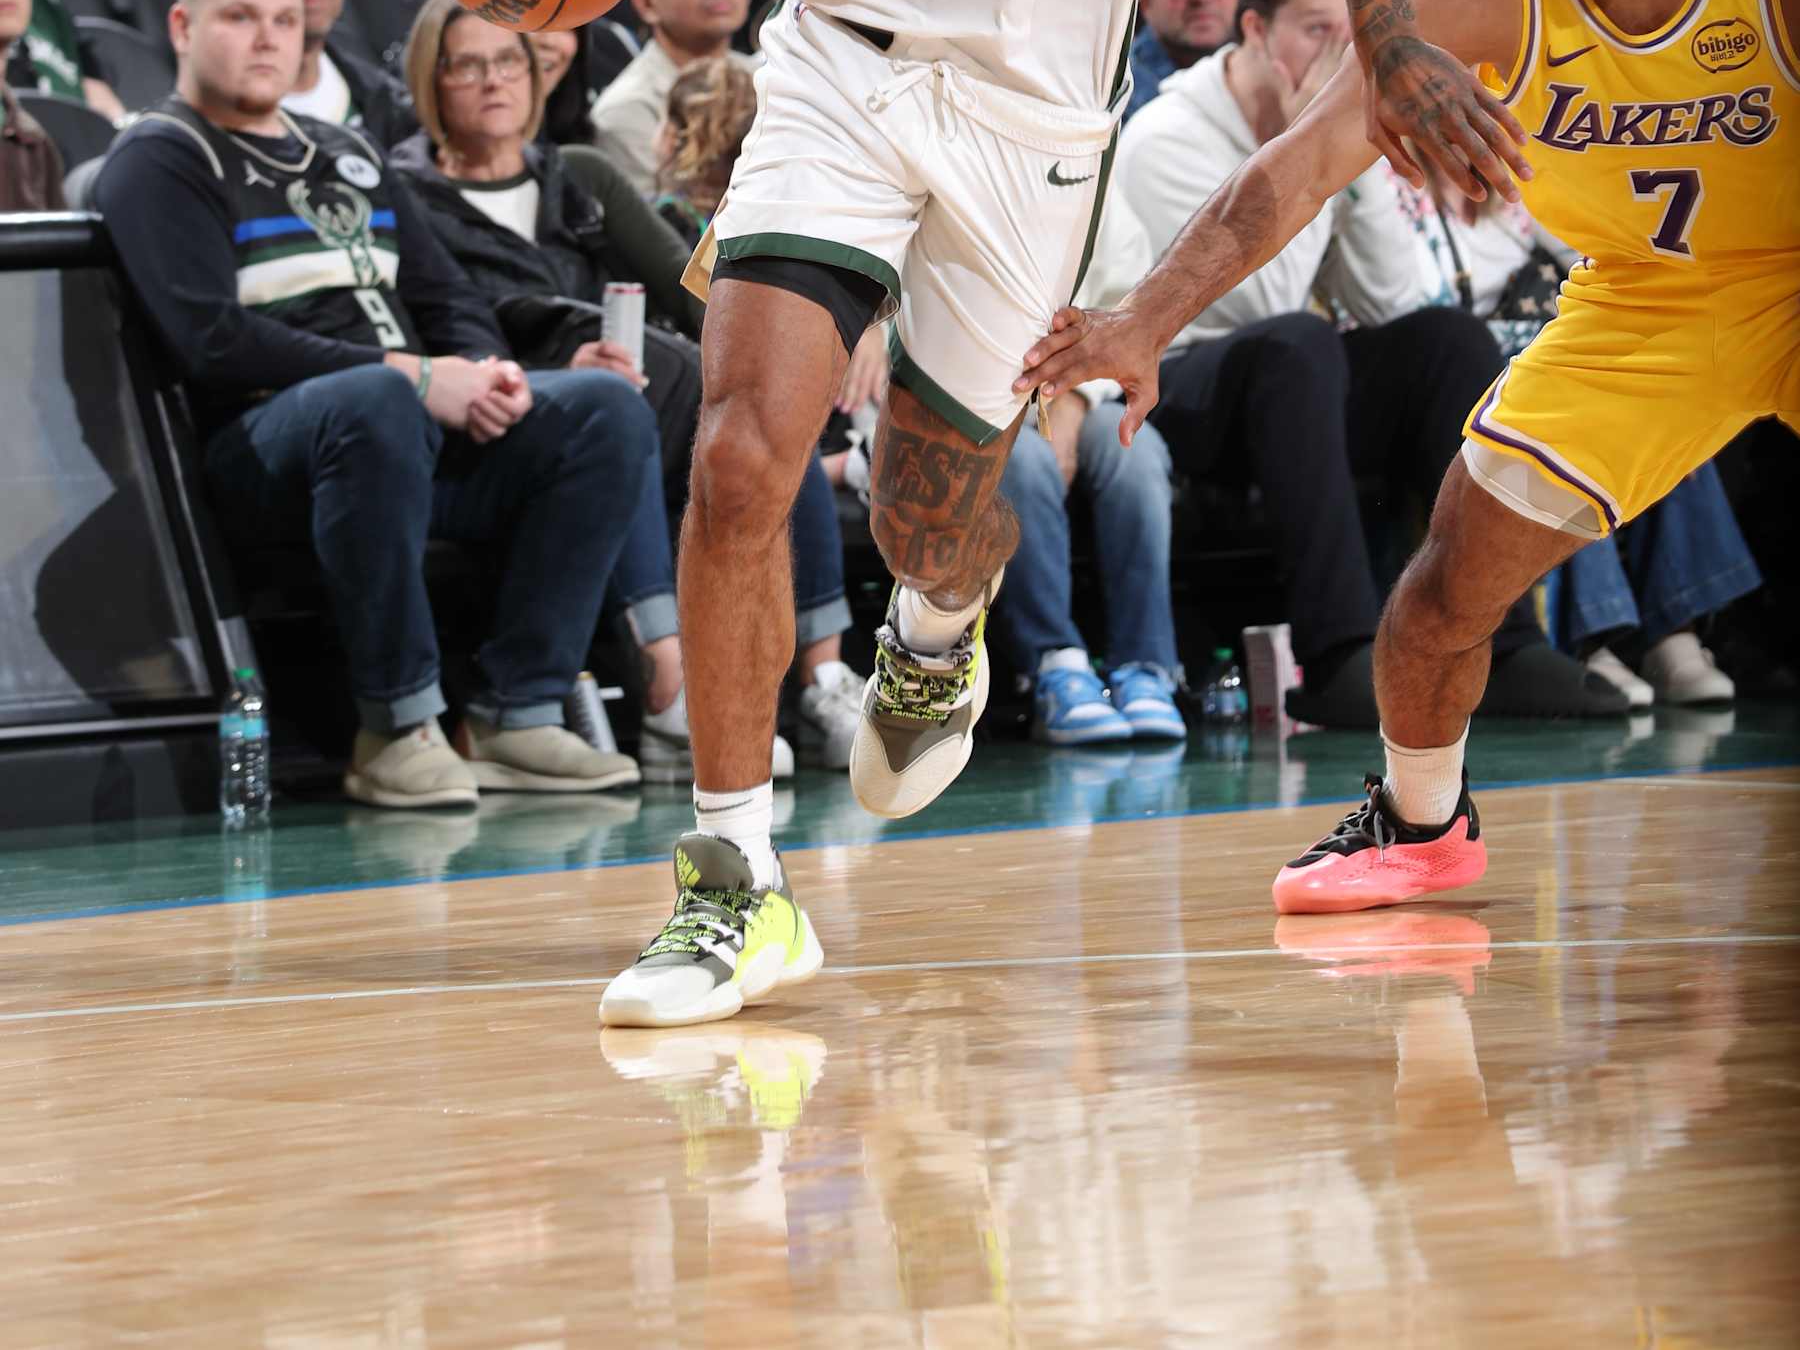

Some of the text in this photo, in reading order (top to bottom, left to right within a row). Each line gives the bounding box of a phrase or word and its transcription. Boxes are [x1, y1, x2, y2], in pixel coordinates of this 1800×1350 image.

[1696, 32, 1756, 56] bibigo
[1530, 81, 1780, 154] LAKERS
[1627, 168, 1705, 261] 7
